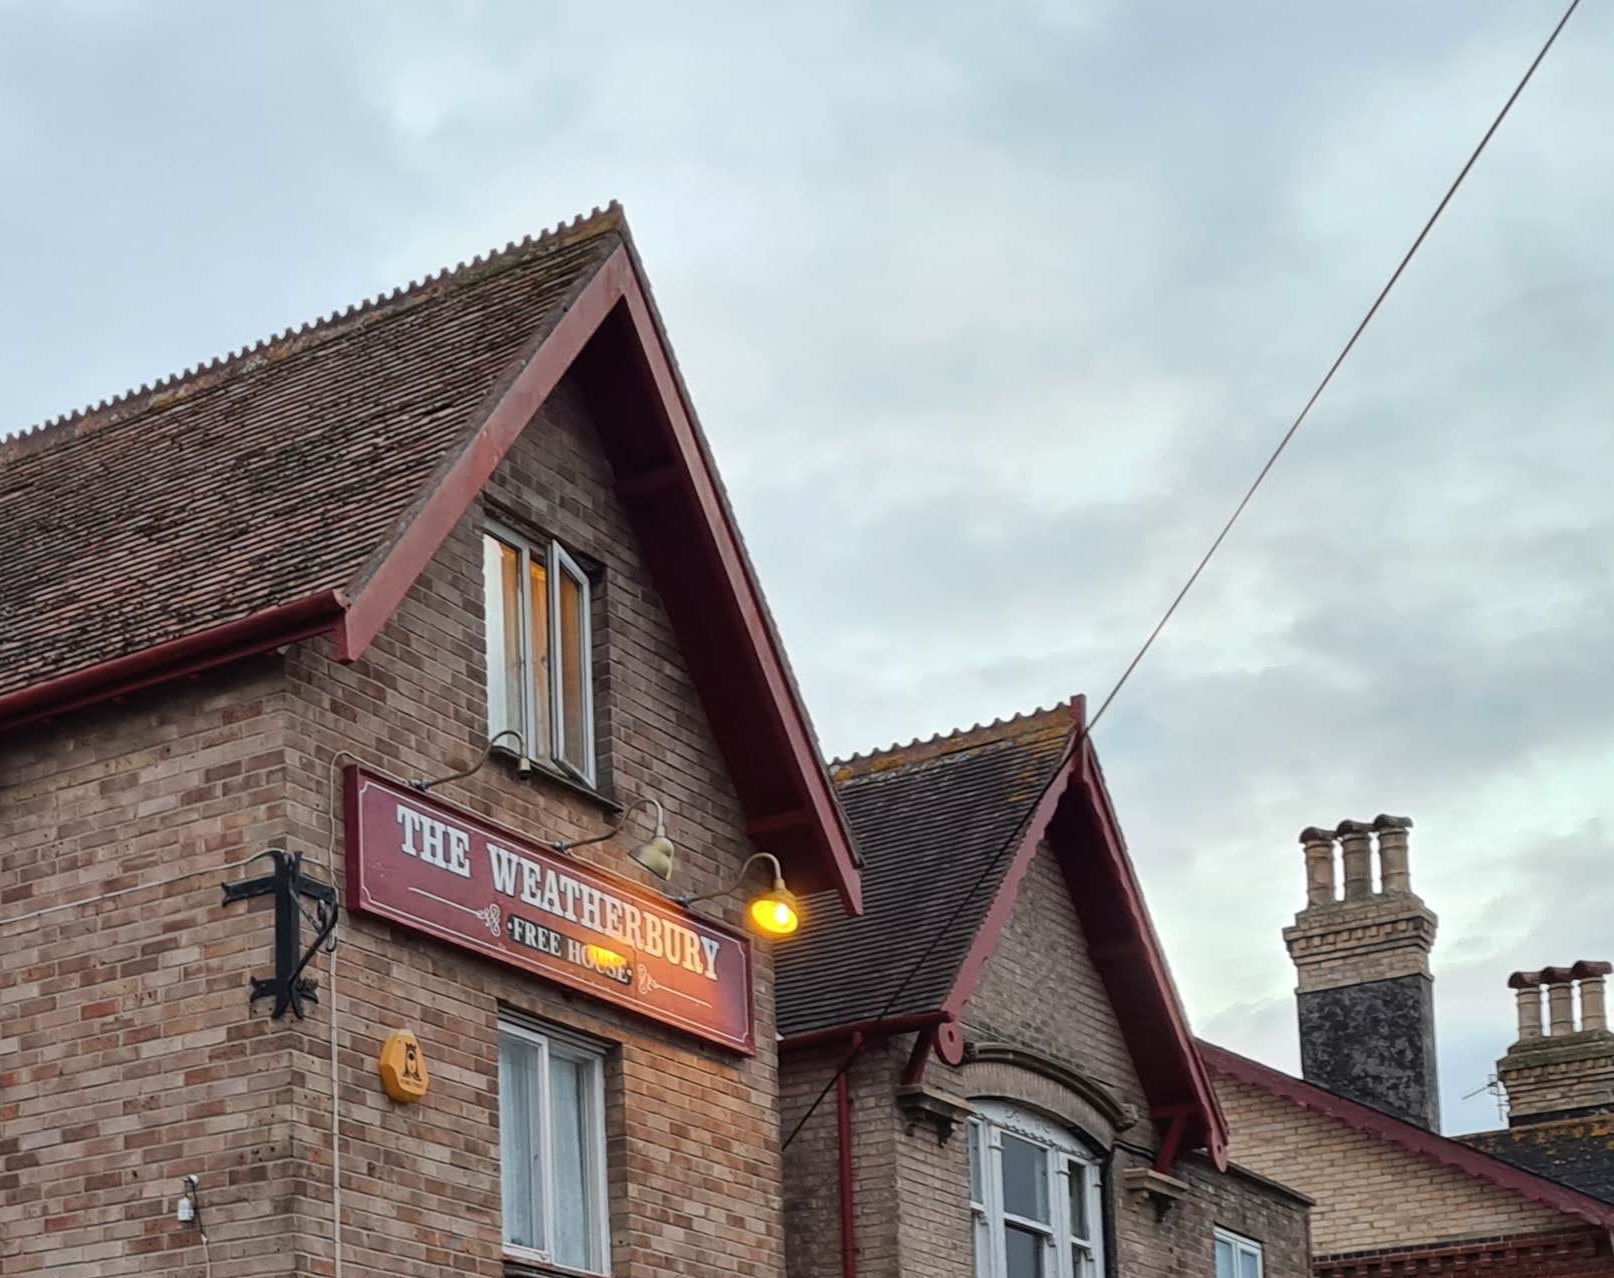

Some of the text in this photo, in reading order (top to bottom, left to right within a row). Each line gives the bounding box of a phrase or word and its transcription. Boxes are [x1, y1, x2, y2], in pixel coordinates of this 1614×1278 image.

[395, 803, 720, 981] THE WEATHERBURY
[513, 921, 562, 959] FREE
